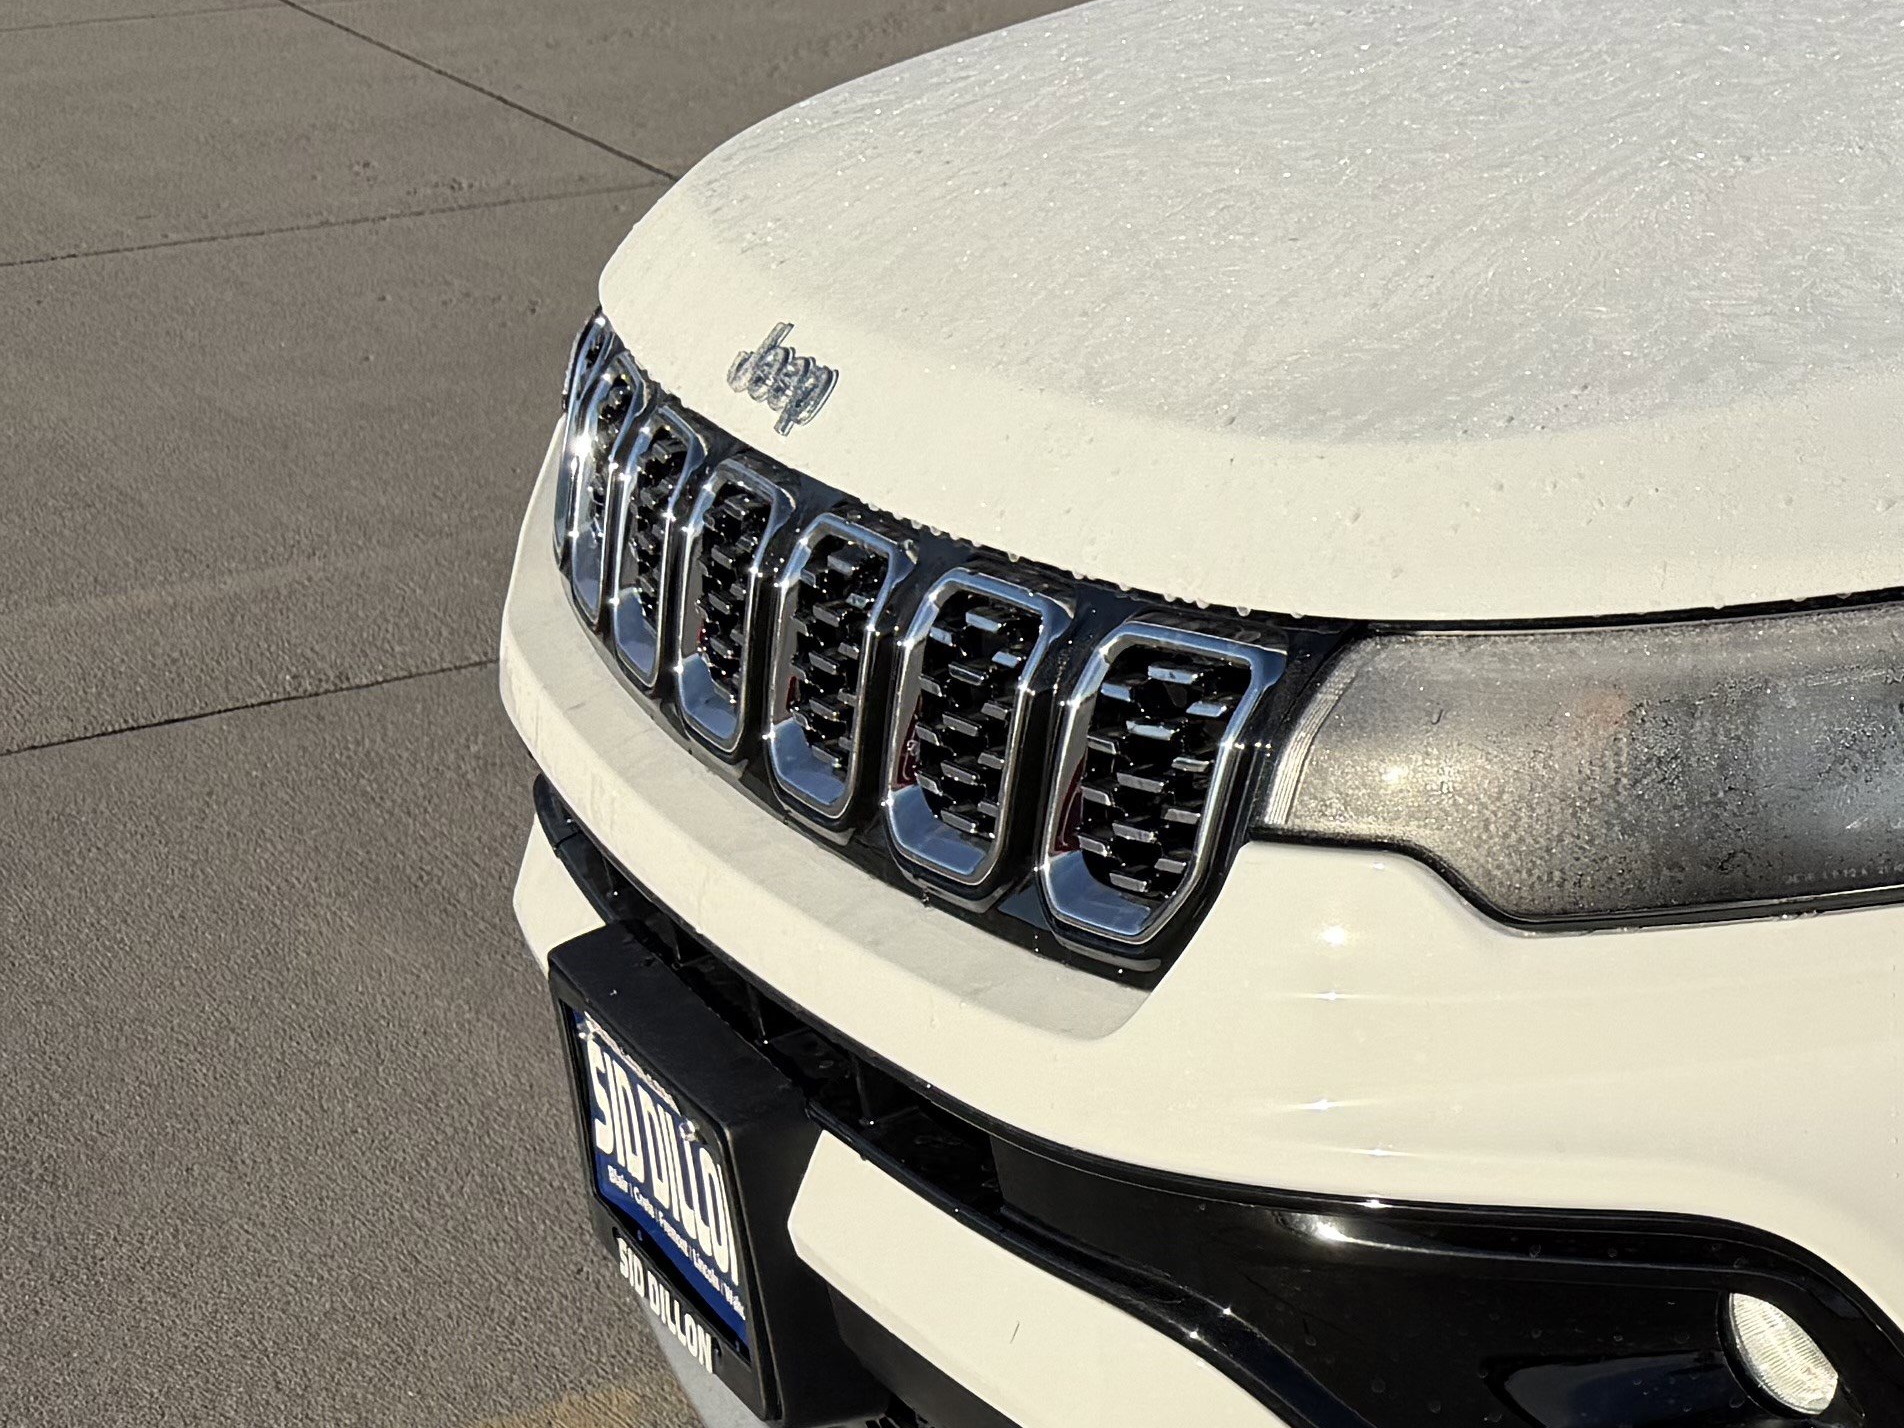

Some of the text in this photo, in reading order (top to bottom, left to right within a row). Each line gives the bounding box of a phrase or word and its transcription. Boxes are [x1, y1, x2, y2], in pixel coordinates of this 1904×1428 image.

[726, 321, 840, 437] Jeep
[586, 1036, 645, 1184] SID
[616, 1236, 645, 1299] SID
[647, 1270, 713, 1374] DILLON
